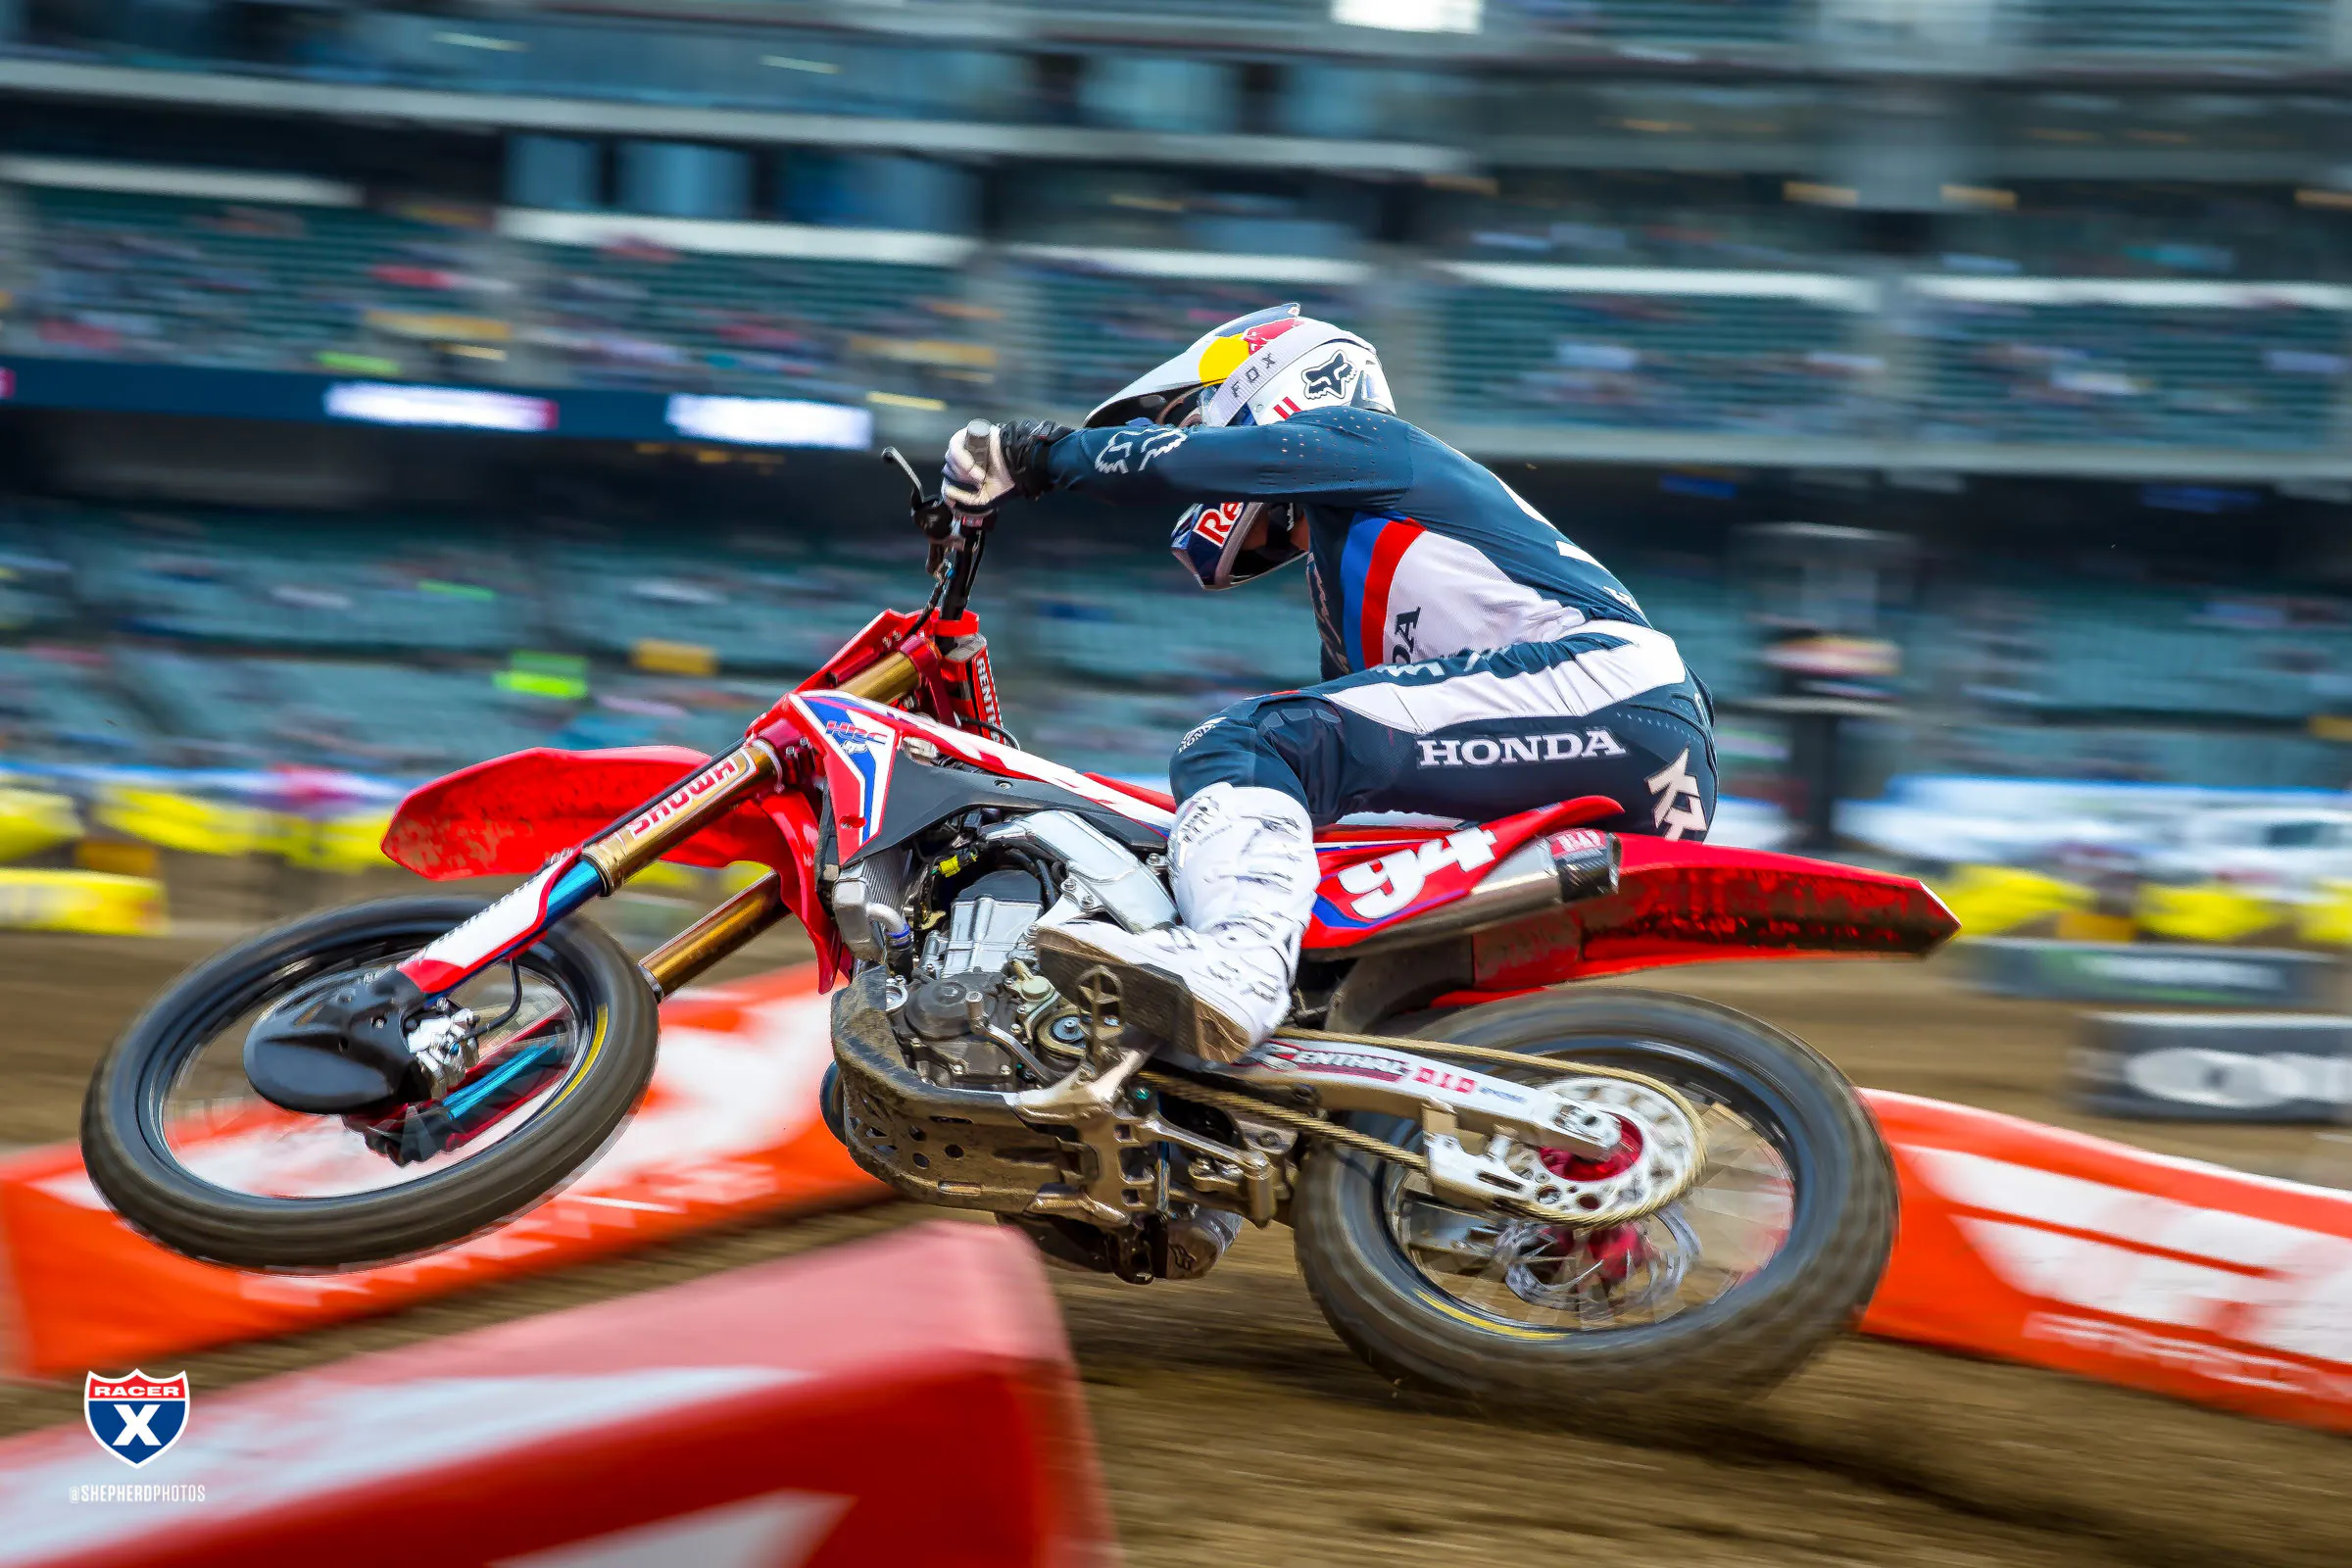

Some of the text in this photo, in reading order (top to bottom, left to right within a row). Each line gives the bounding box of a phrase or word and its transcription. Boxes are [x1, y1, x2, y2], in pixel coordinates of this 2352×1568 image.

[1230, 352, 1276, 398] FOX
[825, 719, 888, 746] HRC
[1416, 729, 1627, 766] HONDA
[625, 757, 739, 840] SHOWA
[1337, 826, 1497, 919] 94
